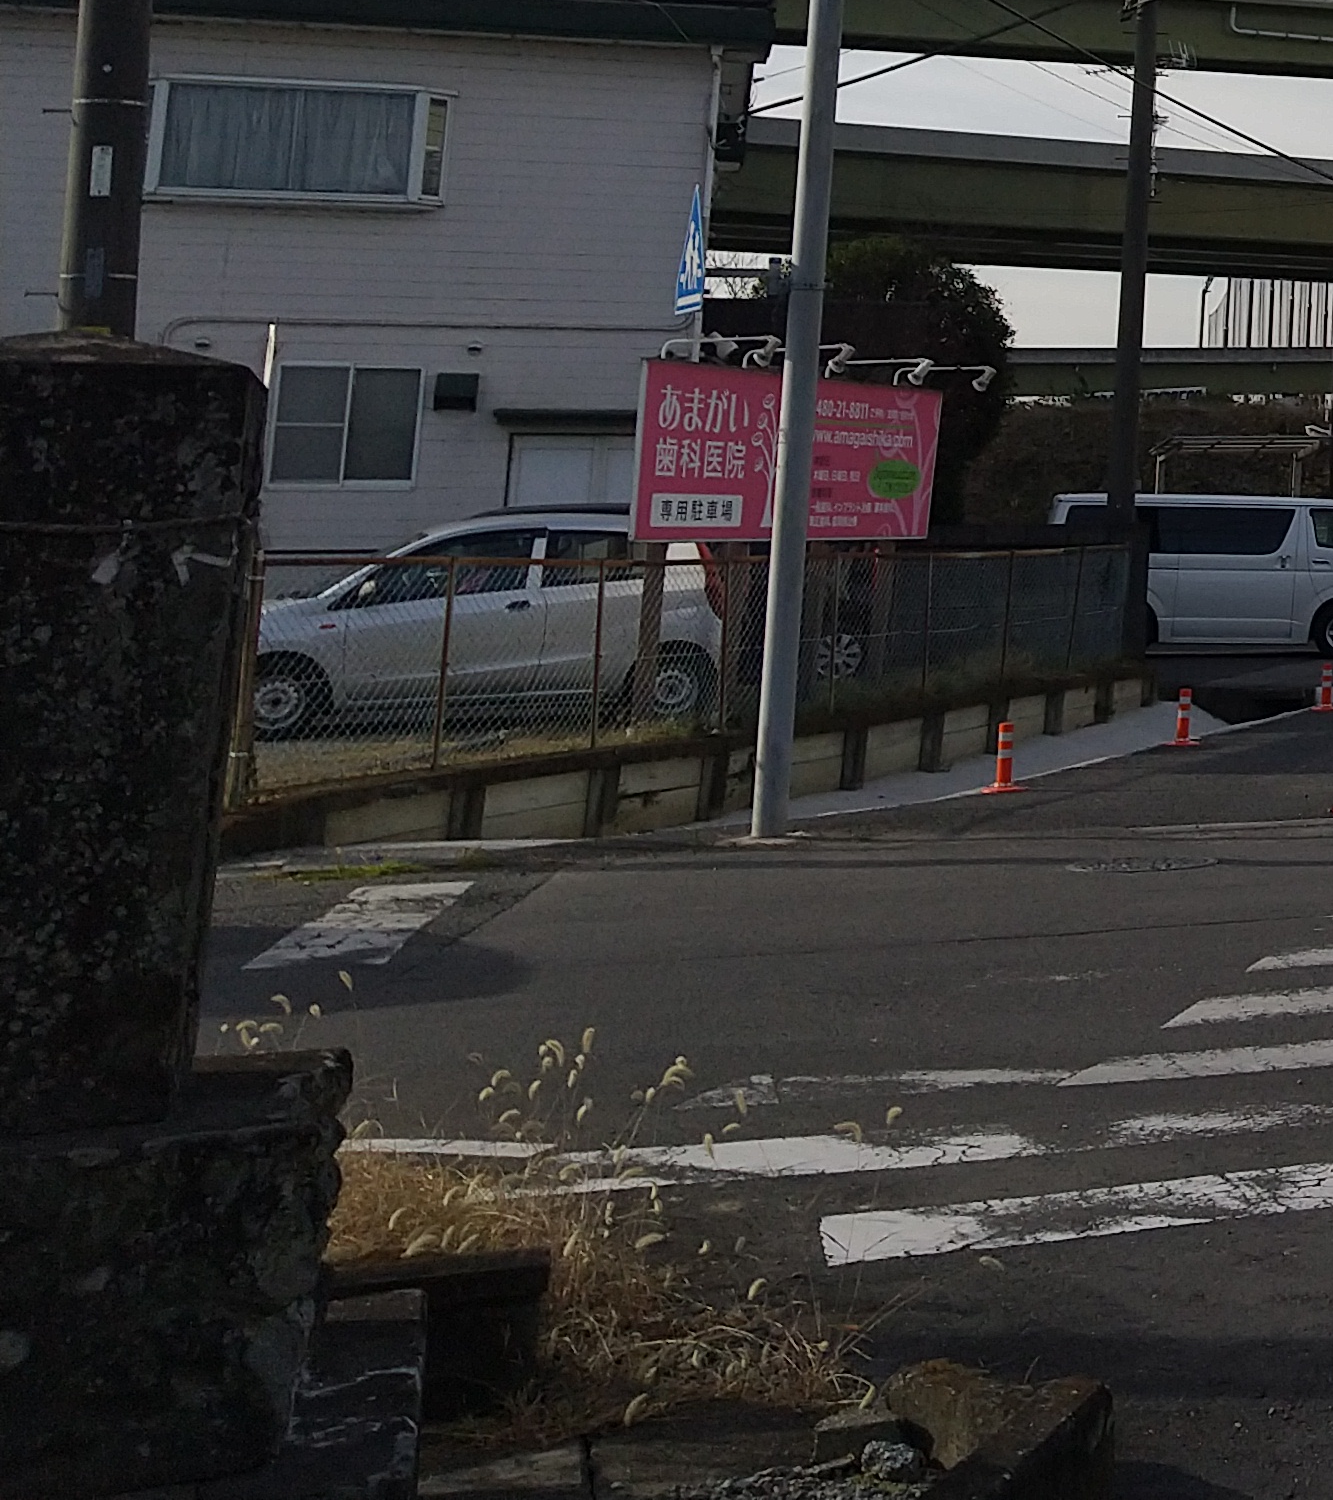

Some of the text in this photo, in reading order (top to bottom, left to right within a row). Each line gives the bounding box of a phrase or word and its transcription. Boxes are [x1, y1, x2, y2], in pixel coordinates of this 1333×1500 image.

[657, 384, 750, 434] あまがい
[654, 435, 747, 481] 歯科医院
[659, 499, 734, 523] 専用駐車場
